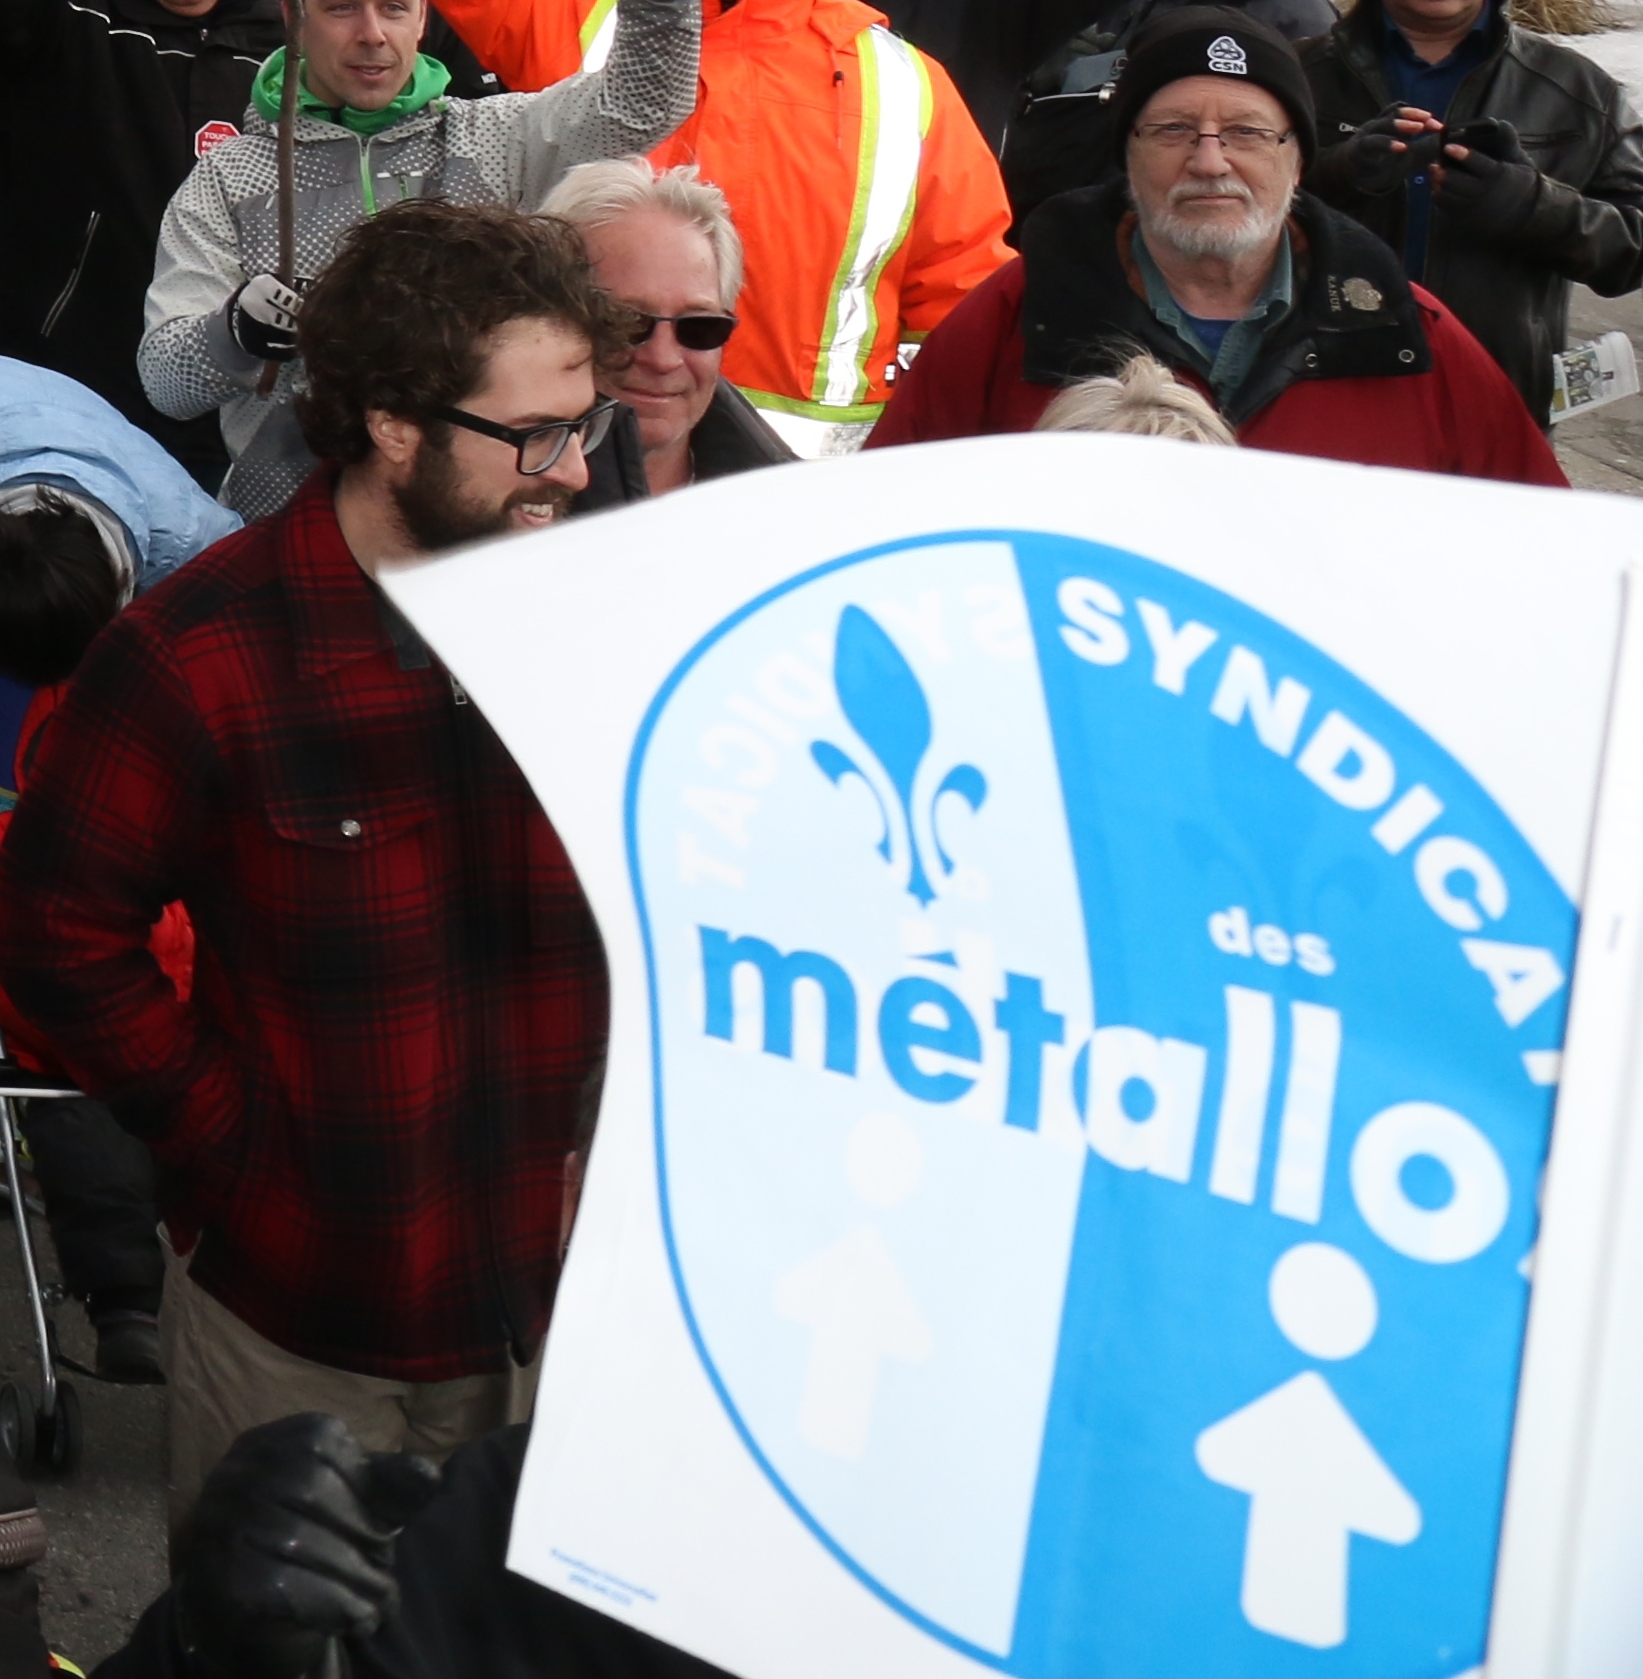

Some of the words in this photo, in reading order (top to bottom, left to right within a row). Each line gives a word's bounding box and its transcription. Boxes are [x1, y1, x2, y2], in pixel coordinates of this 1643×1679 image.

[1212, 61, 1246, 72] CSN
[1052, 573, 1565, 1088] SYNDICA
[1207, 906, 1337, 979] des
[696, 922, 1520, 1265] métallo
